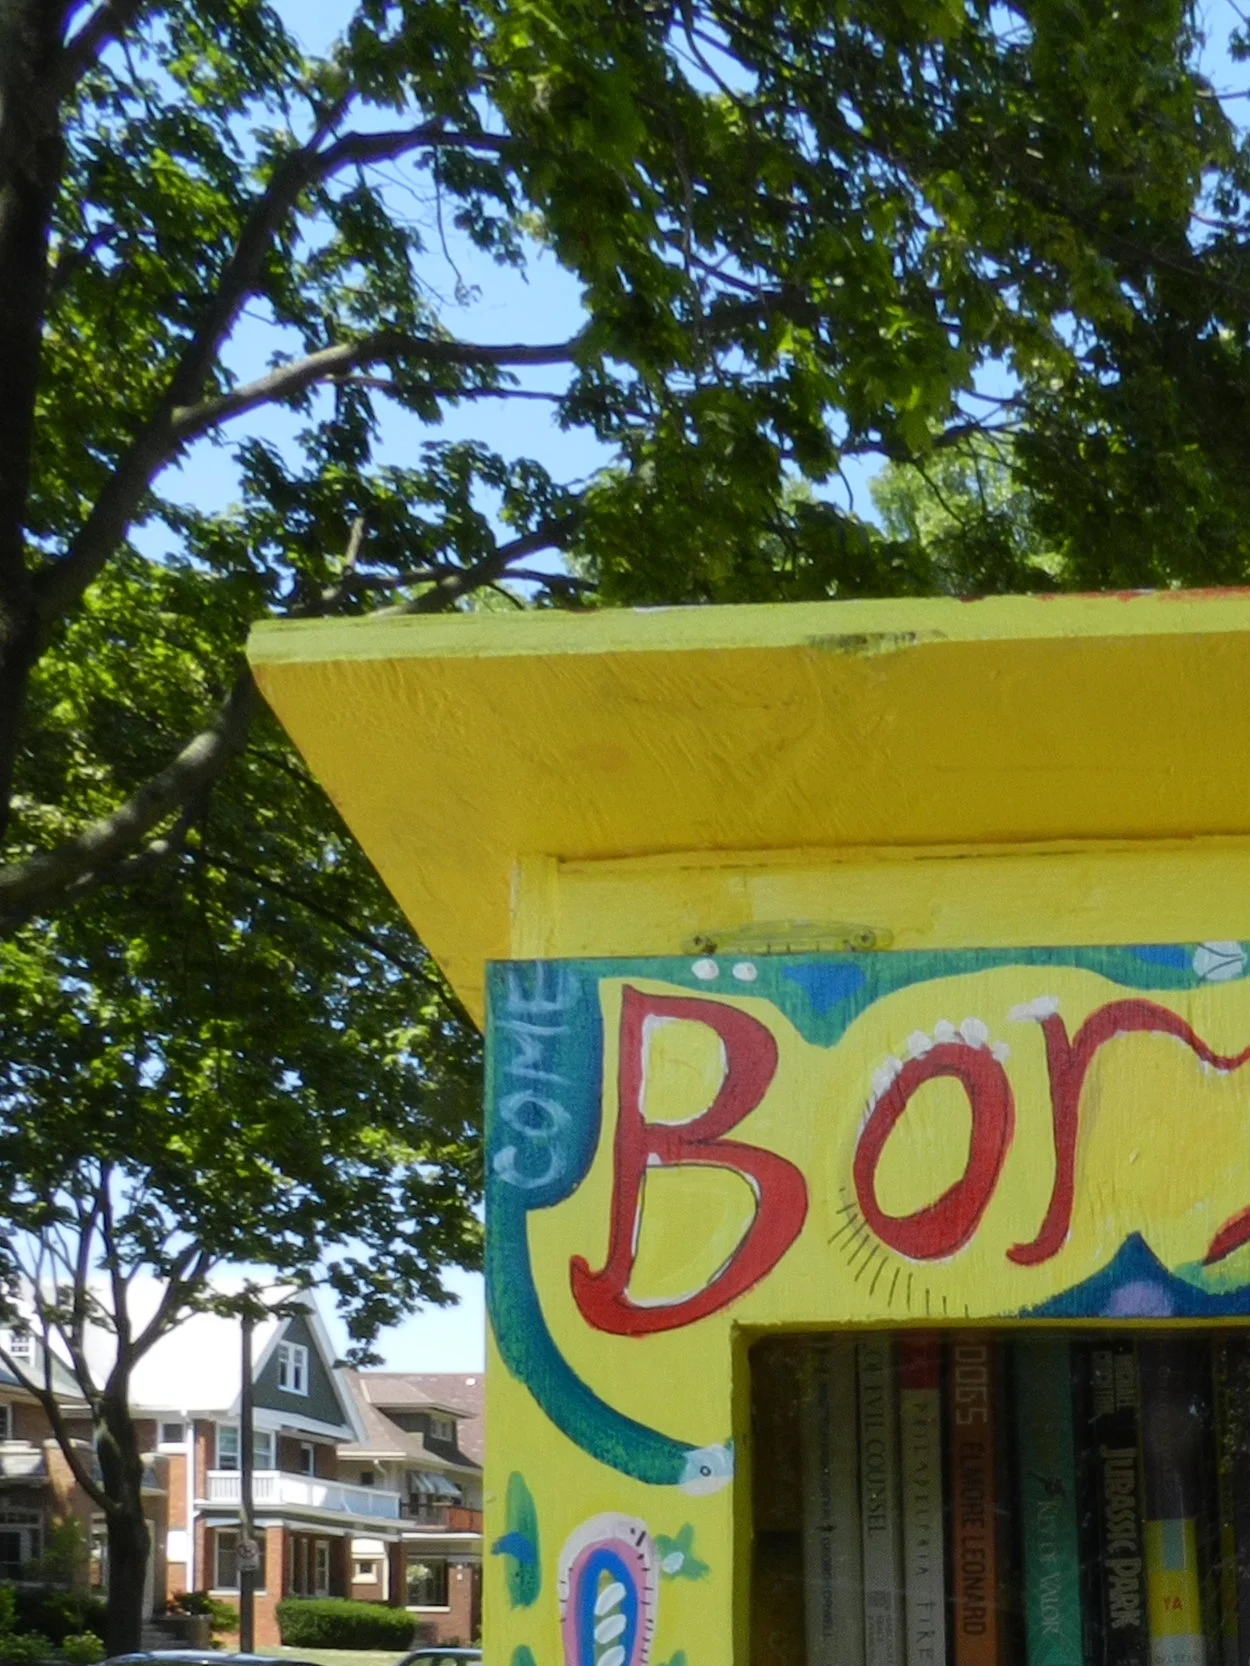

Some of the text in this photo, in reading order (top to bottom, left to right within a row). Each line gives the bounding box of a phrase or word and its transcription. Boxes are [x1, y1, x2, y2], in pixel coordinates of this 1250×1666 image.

[864, 1385, 884, 1433] EVIL
[864, 1438, 886, 1539] COUNSEL
[958, 1441, 986, 1528] ELMORE
[1099, 1445, 1137, 1554] JURASSIC
[961, 1535, 987, 1637] LEONARD
[1039, 1571, 1061, 1637] VALOR
[1105, 1557, 1141, 1630] PARK
[915, 1601, 935, 1661] FIRE
